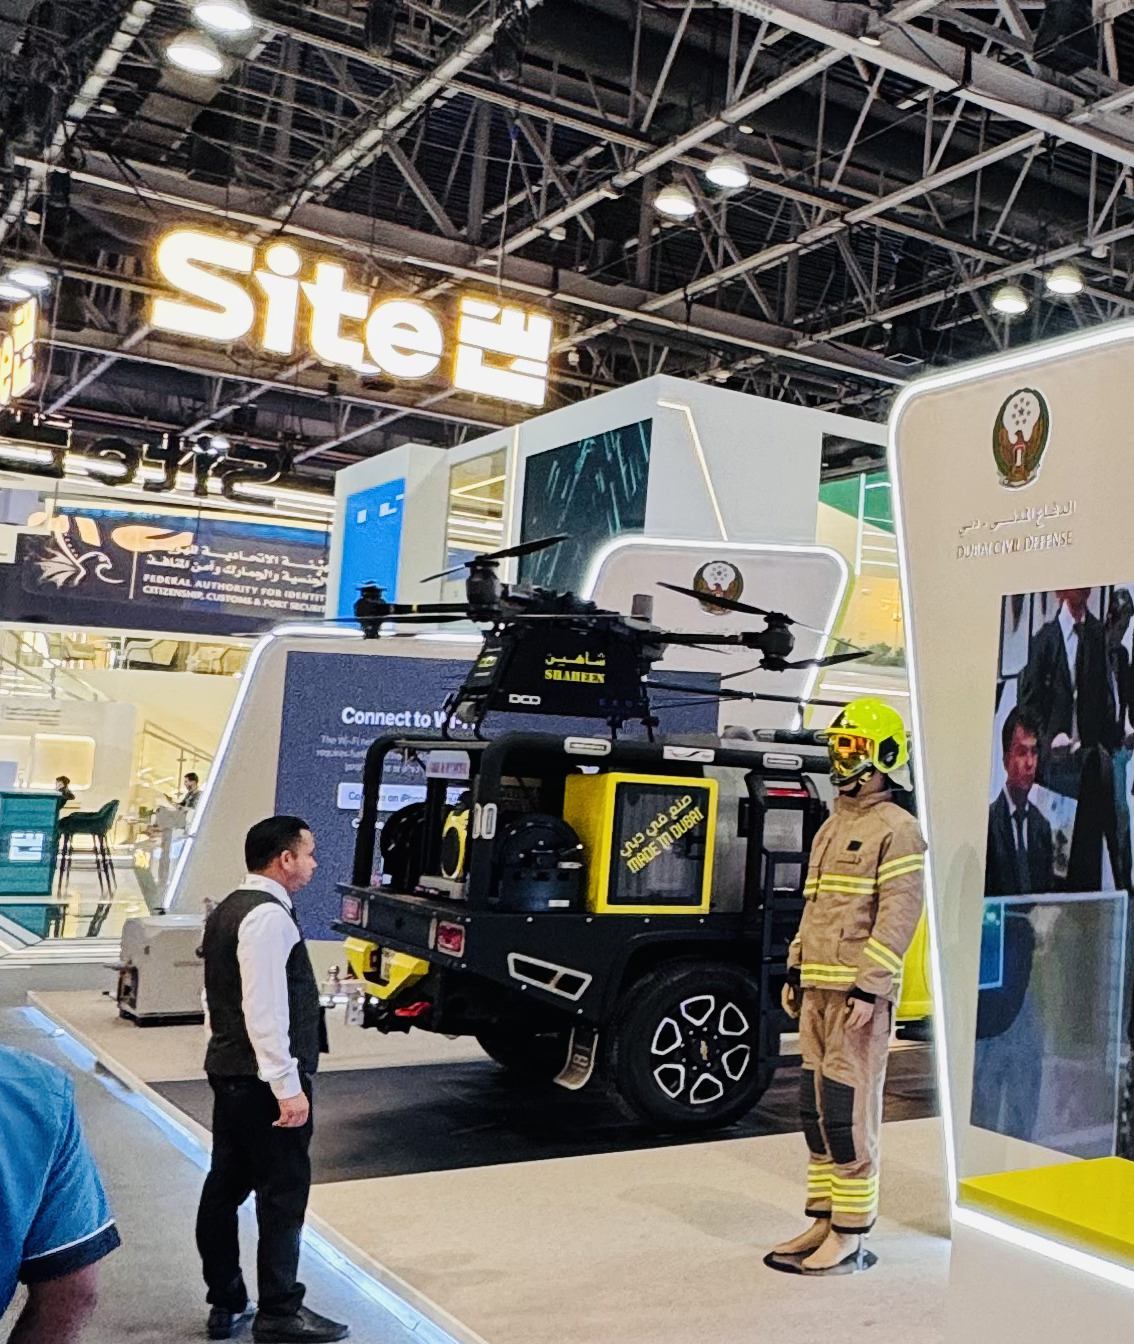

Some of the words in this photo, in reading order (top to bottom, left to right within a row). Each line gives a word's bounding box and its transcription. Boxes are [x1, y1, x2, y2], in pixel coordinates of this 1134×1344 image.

[151, 229, 445, 380] Site
[956, 540, 992, 560] DUBAI
[993, 537, 1021, 555] CIVIL
[1024, 530, 1073, 552] DEFENSE
[143, 573, 192, 587] FEDERAL
[194, 580, 259, 595] AUTHORITY
[260, 587, 282, 597] FOR
[284, 590, 327, 602] IDENTIT
[206, 592, 253, 605] CUSTOMS
[544, 669, 605, 683] SHAHEEN
[342, 706, 411, 727] Connect
[414, 710, 432, 728] to
[669, 806, 705, 839] DUBAI
